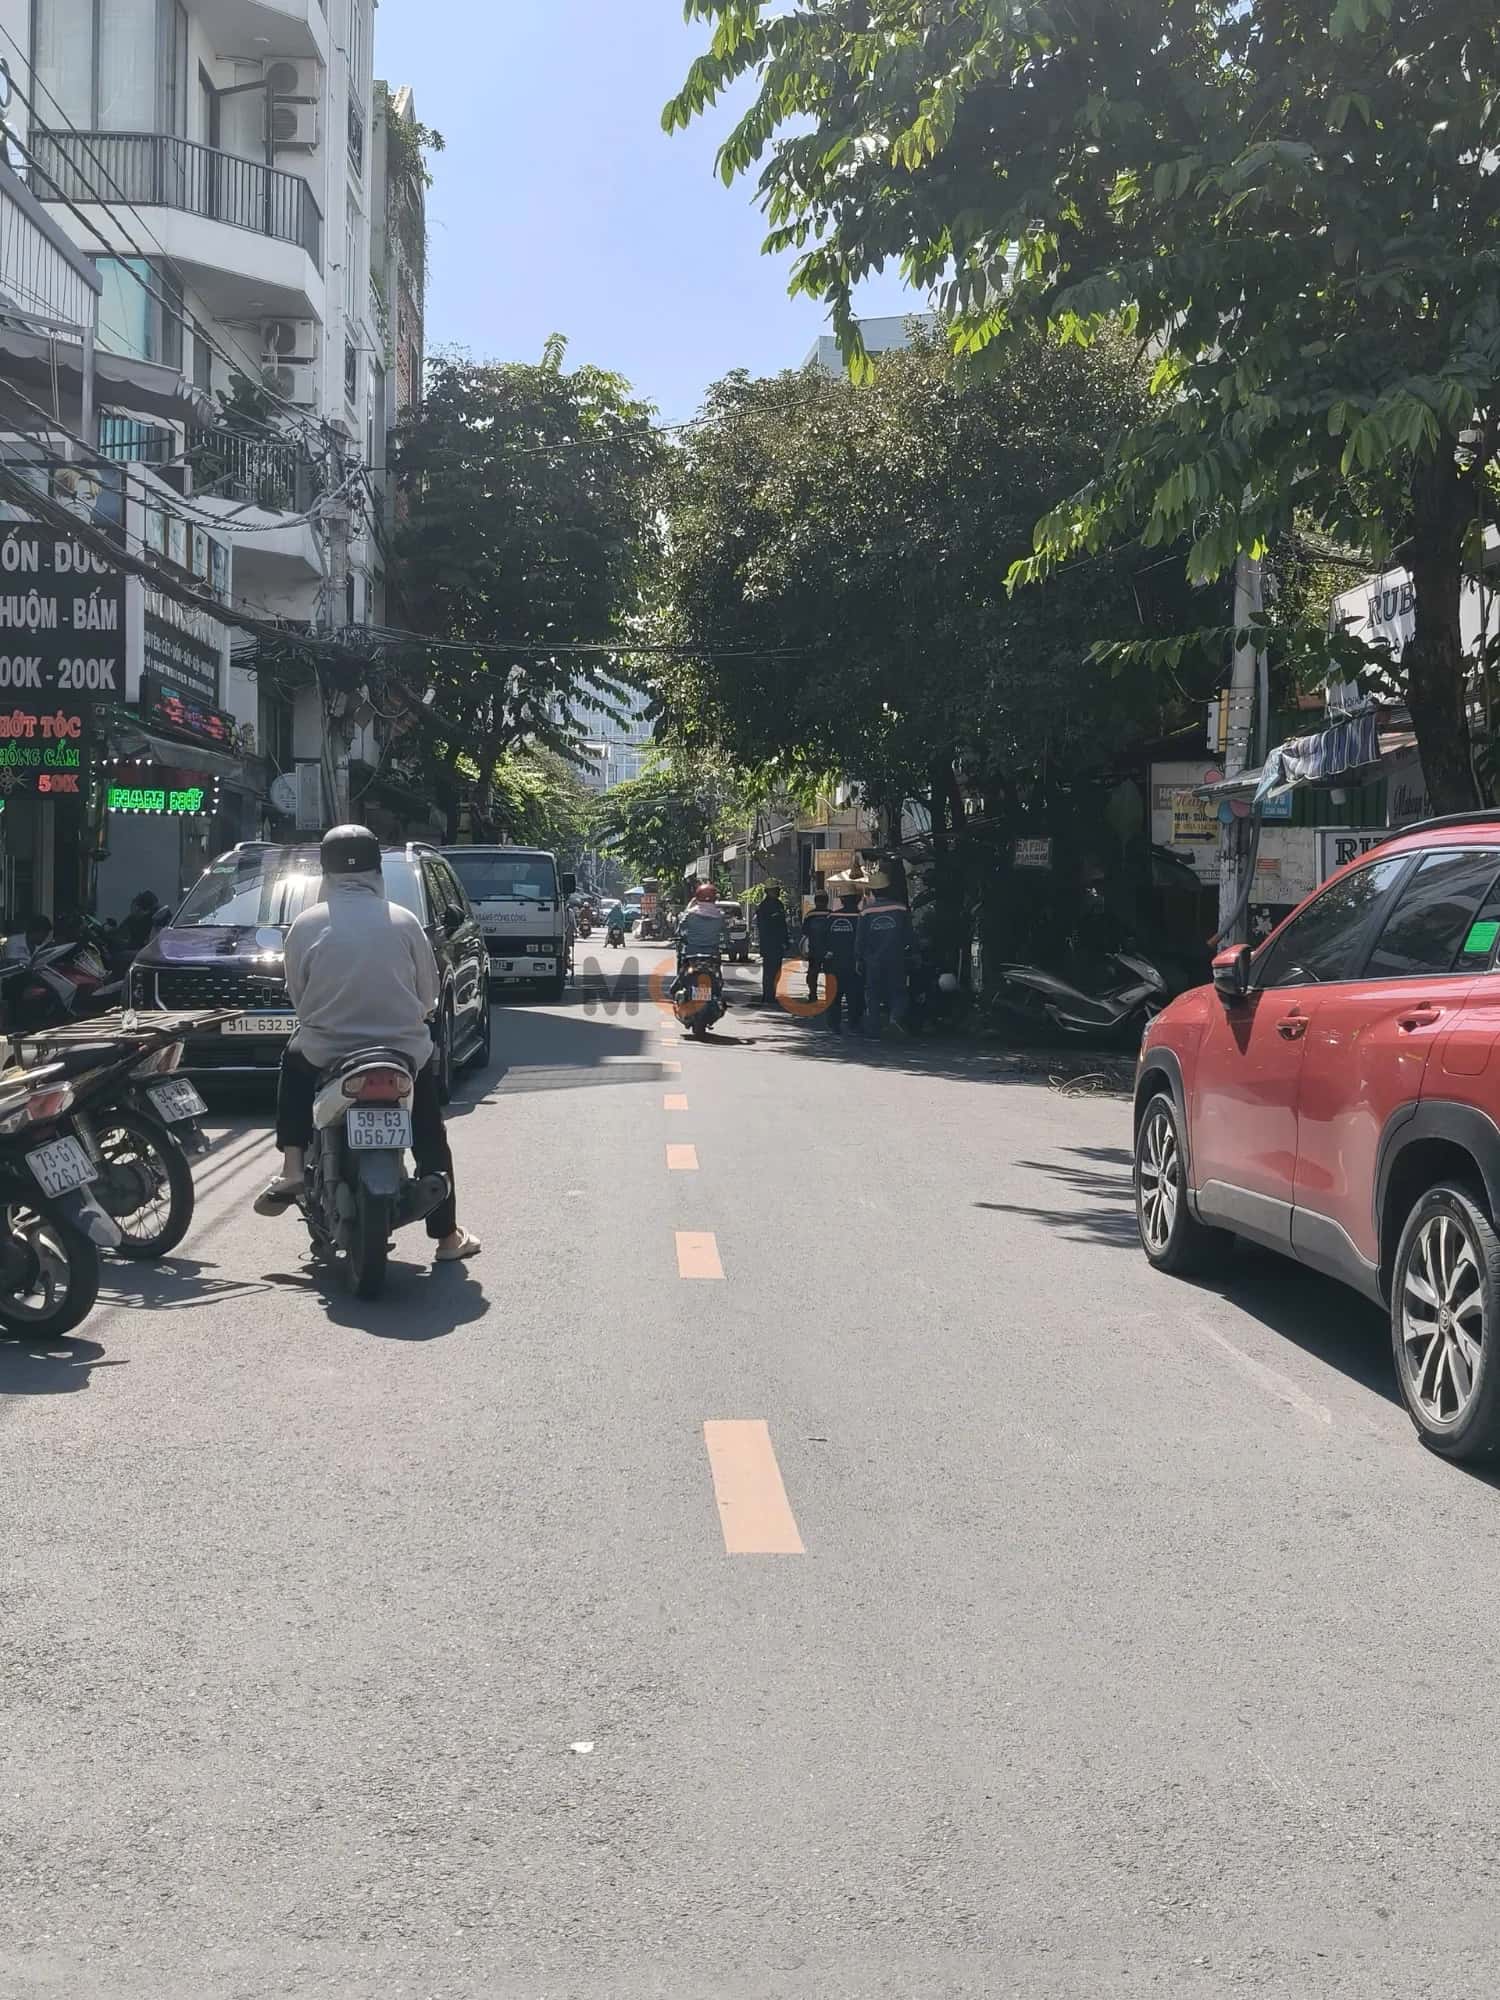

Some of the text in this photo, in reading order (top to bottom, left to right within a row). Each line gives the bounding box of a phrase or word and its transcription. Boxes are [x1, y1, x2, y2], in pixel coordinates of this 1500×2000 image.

[73, 586, 118, 631] BẤM
[58, 657, 117, 690] 200K
[40, 710, 81, 738] TÓC
[38, 774, 80, 793] 50K
[357, 1111, 402, 1128] 59-G3
[353, 1128, 407, 1145] 056.77
